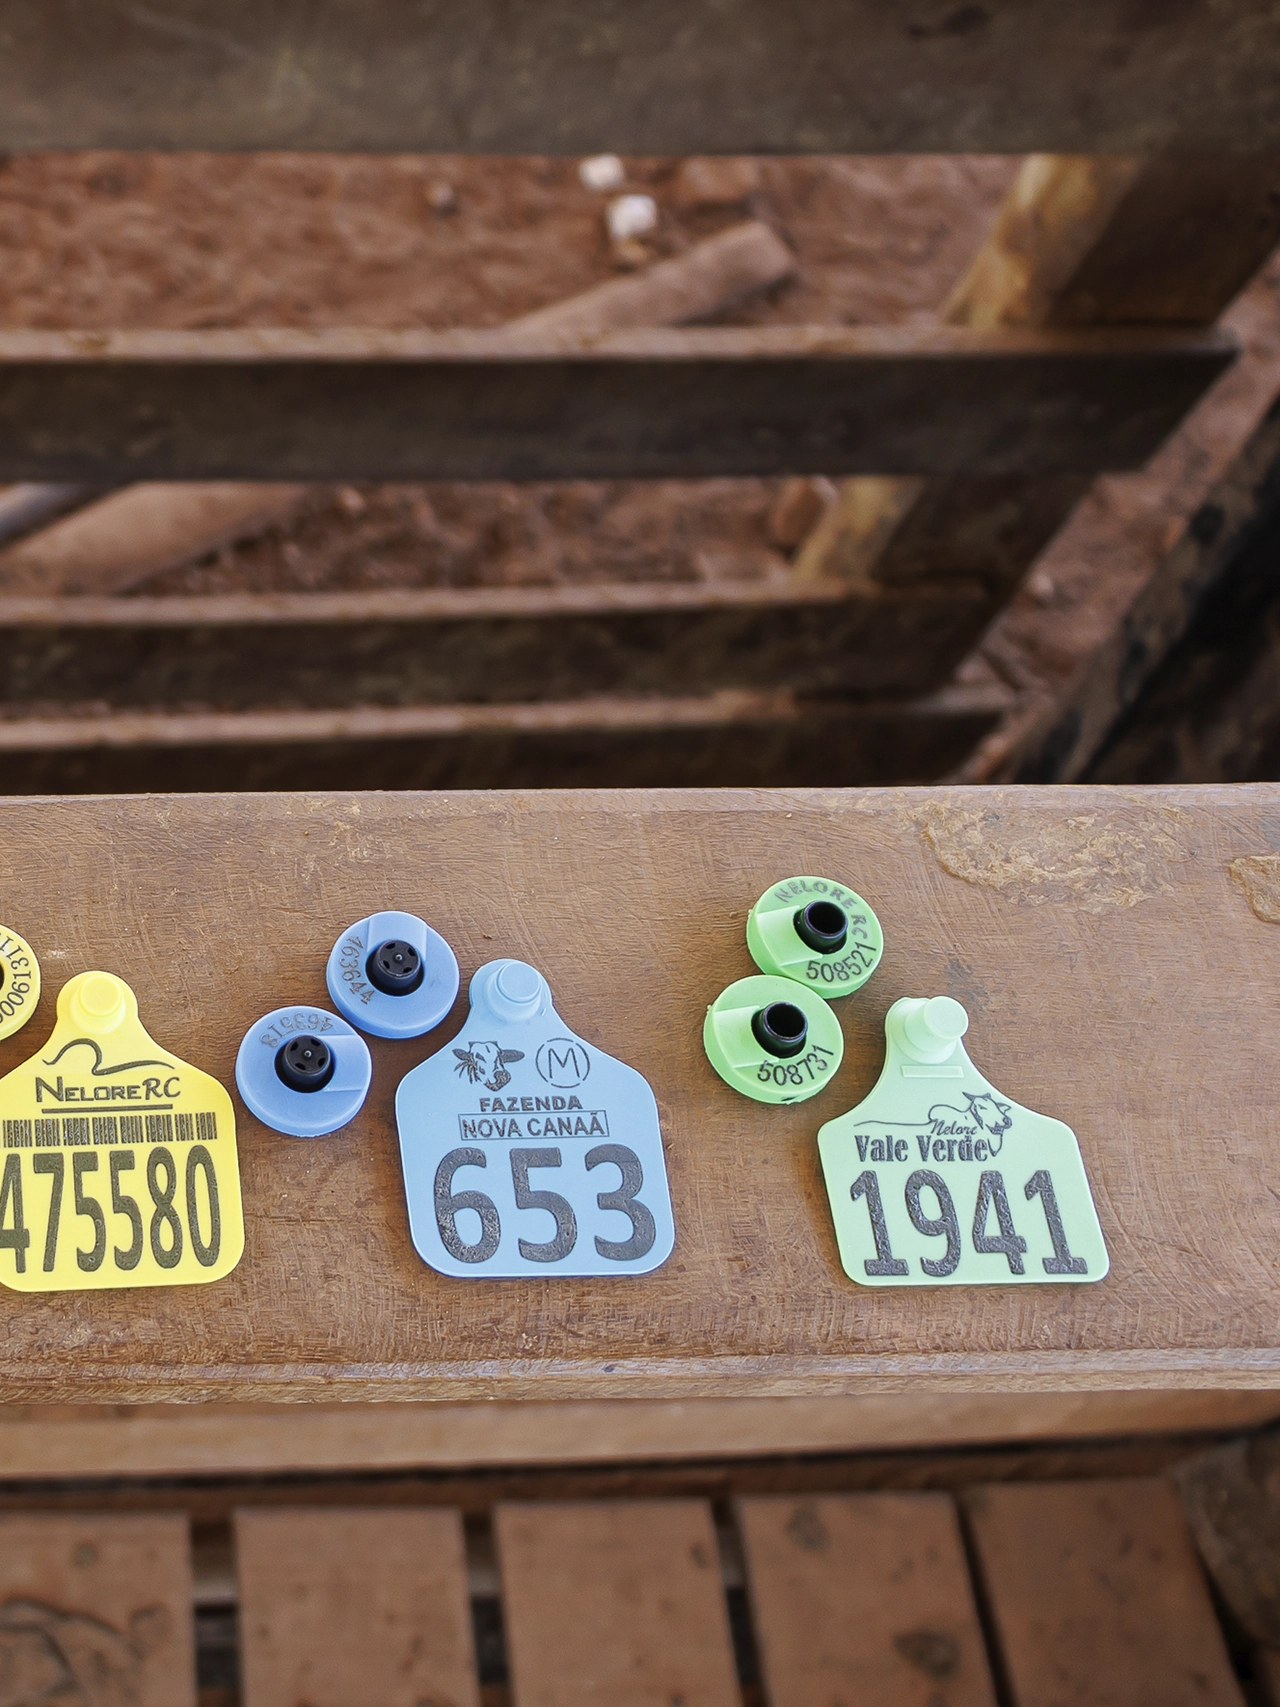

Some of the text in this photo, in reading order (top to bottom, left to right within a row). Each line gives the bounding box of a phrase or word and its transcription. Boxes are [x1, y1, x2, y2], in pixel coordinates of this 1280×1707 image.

[774, 879, 858, 909] NELORE
[338, 934, 376, 1006] 463644
[805, 941, 878, 983] 508521
[259, 1012, 334, 1049] 463518
[757, 1044, 835, 1086] 508731
[478, 1095, 583, 1112] FAZENDA
[462, 1112, 606, 1138] NOVA CANAÃ
[930, 1117, 978, 1137] Nelore
[854, 1134, 989, 1162] Vale Verde
[433, 1143, 656, 1263] 653
[850, 1168, 1089, 1277] 1941
